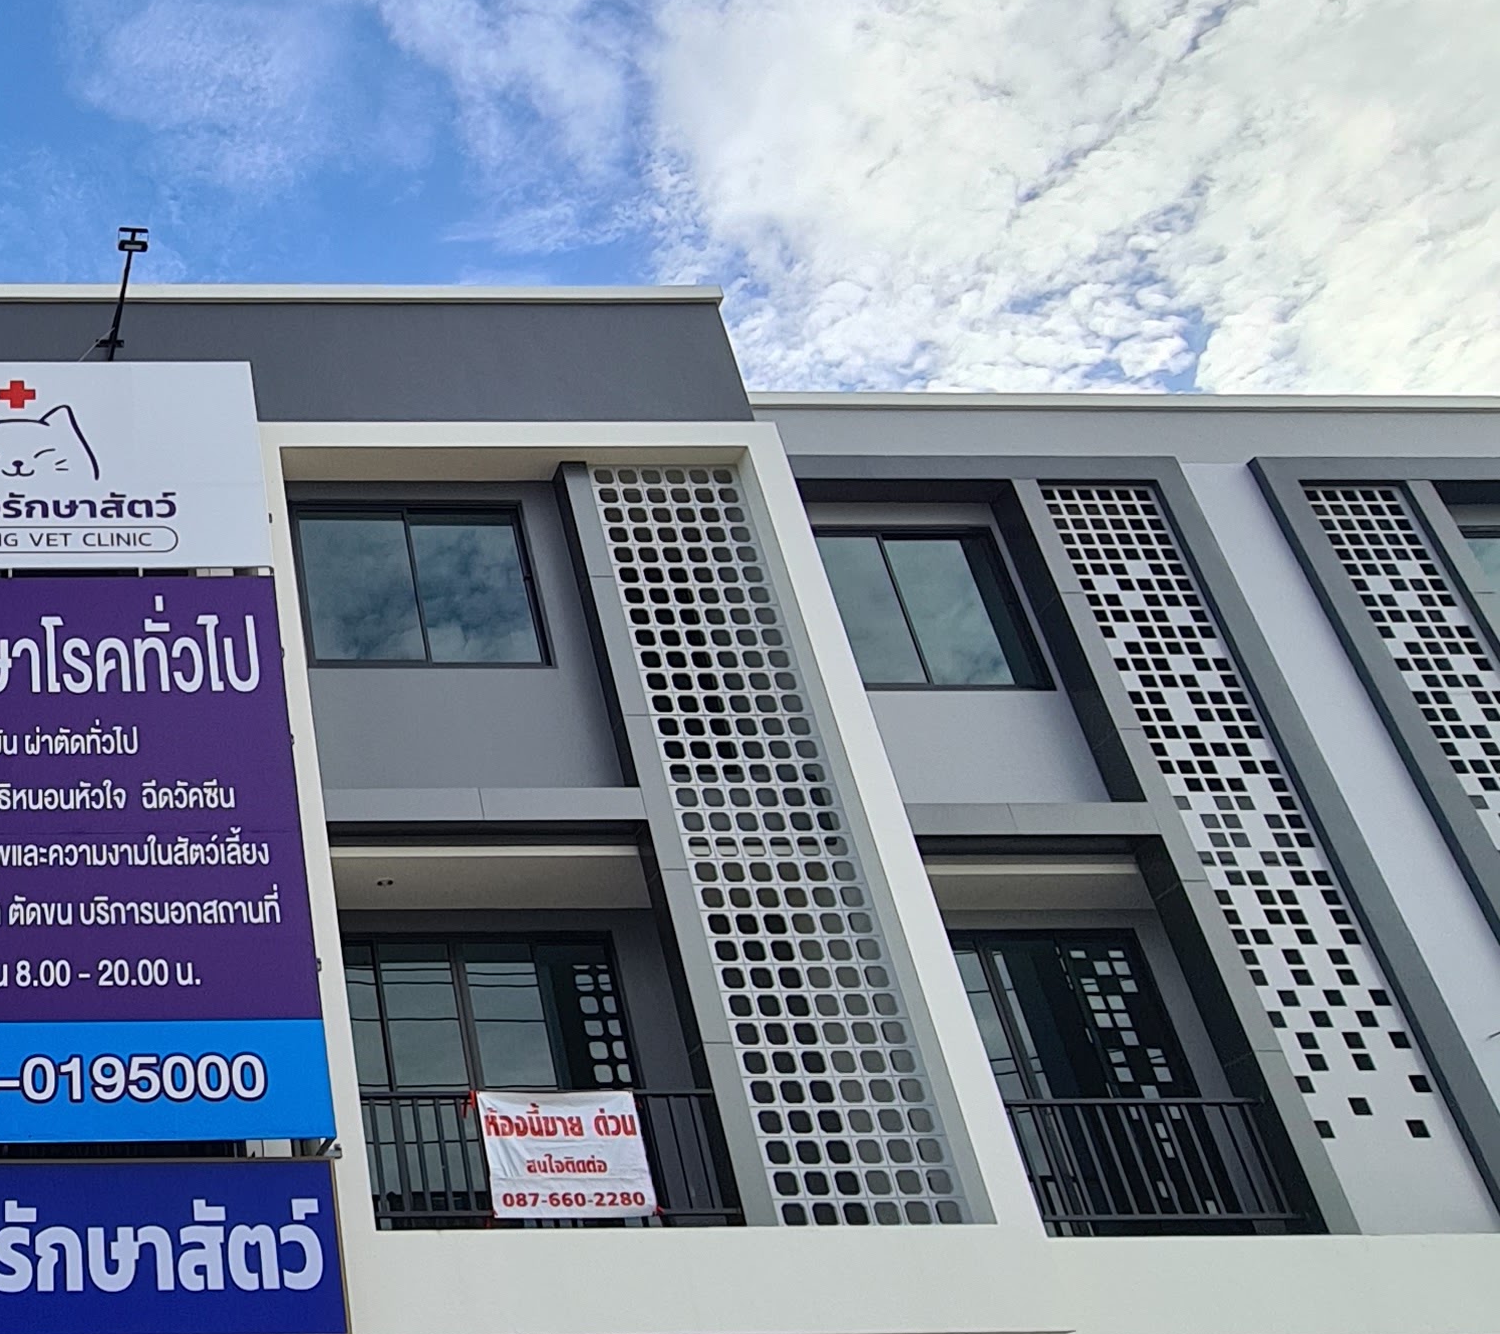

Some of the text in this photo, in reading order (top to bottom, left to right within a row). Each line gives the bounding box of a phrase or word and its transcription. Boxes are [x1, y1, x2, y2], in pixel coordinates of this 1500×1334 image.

[29, 532, 73, 547] VET
[82, 532, 153, 547] CLINIC
[24, 719, 139, 755] ผ่าตัดทั่วไป
[142, 779, 236, 809] ฉีดวัคซีน
[8, 895, 72, 925] ตัดขน
[80, 884, 281, 925] บริการนอกสถานที่
[15, 960, 71, 987] 8.00
[98, 959, 169, 986] 20.00
[176, 962, 201, 985] น.
[483, 1103, 638, 1137] ห้องนี้ขาย ด่วน
[526, 1154, 608, 1173] สนใจติดต่อ
[502, 1192, 645, 1207] 087-660-2280
